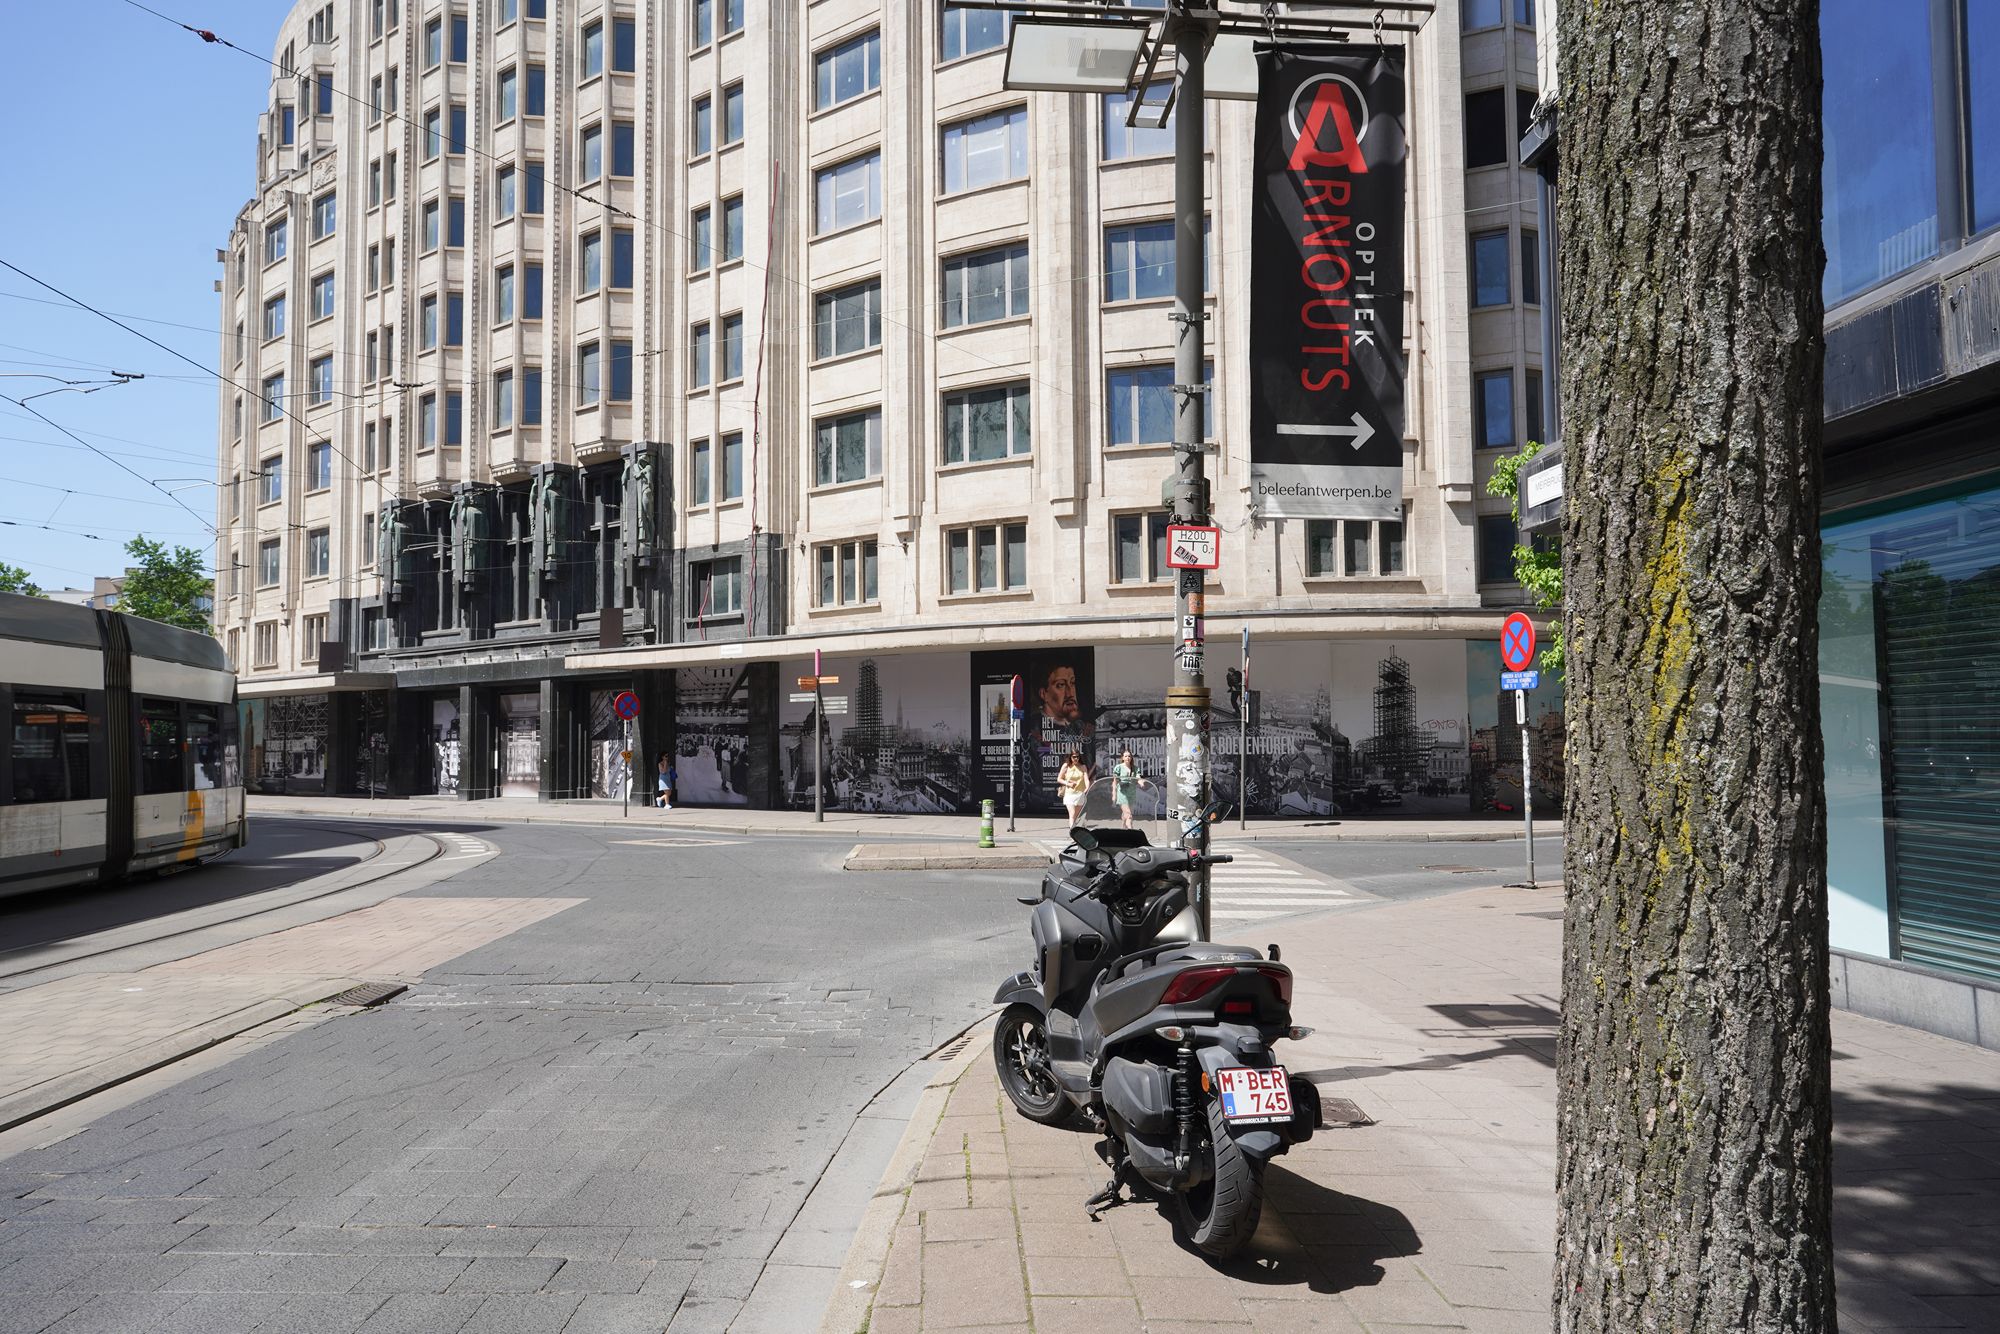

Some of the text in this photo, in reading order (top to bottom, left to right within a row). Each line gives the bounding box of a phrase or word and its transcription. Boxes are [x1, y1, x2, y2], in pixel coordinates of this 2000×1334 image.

[1286, 83, 1368, 391] ARNOUTS
[1355, 222, 1375, 347] OPTIEK
[1257, 481, 1393, 500] beleefantwerpen.be
[1180, 529, 1206, 540] H200
[1042, 717, 1054, 729] HET
[1042, 730, 1060, 742] KOMT
[1109, 737, 1121, 755] DE
[1123, 737, 1167, 755] TOEKOM
[1042, 756, 1059, 767] GOED
[1250, 1091, 1288, 1113] 745
